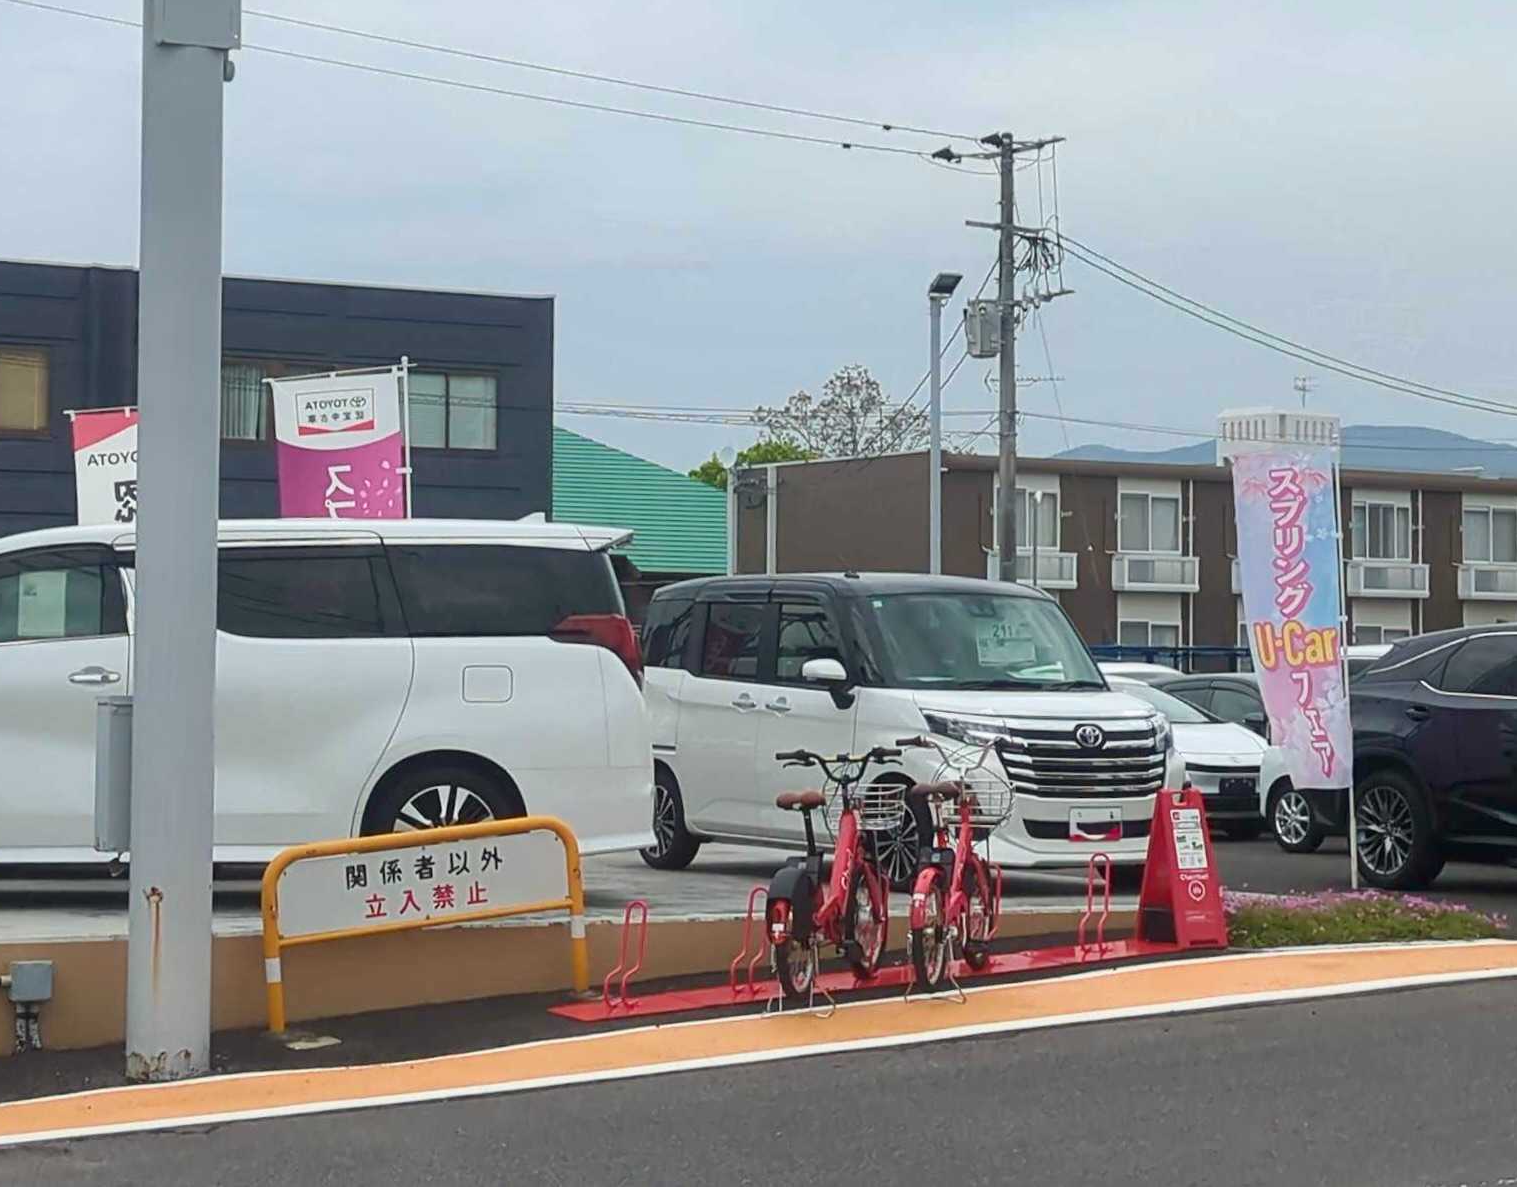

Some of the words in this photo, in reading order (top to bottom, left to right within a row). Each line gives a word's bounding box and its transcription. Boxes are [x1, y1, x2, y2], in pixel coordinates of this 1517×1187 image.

[1268, 469, 1311, 618] スプリング
[1291, 670, 1335, 778] フェア
[345, 846, 504, 891] 関係者以外
[365, 881, 489, 919] 立入禁止
